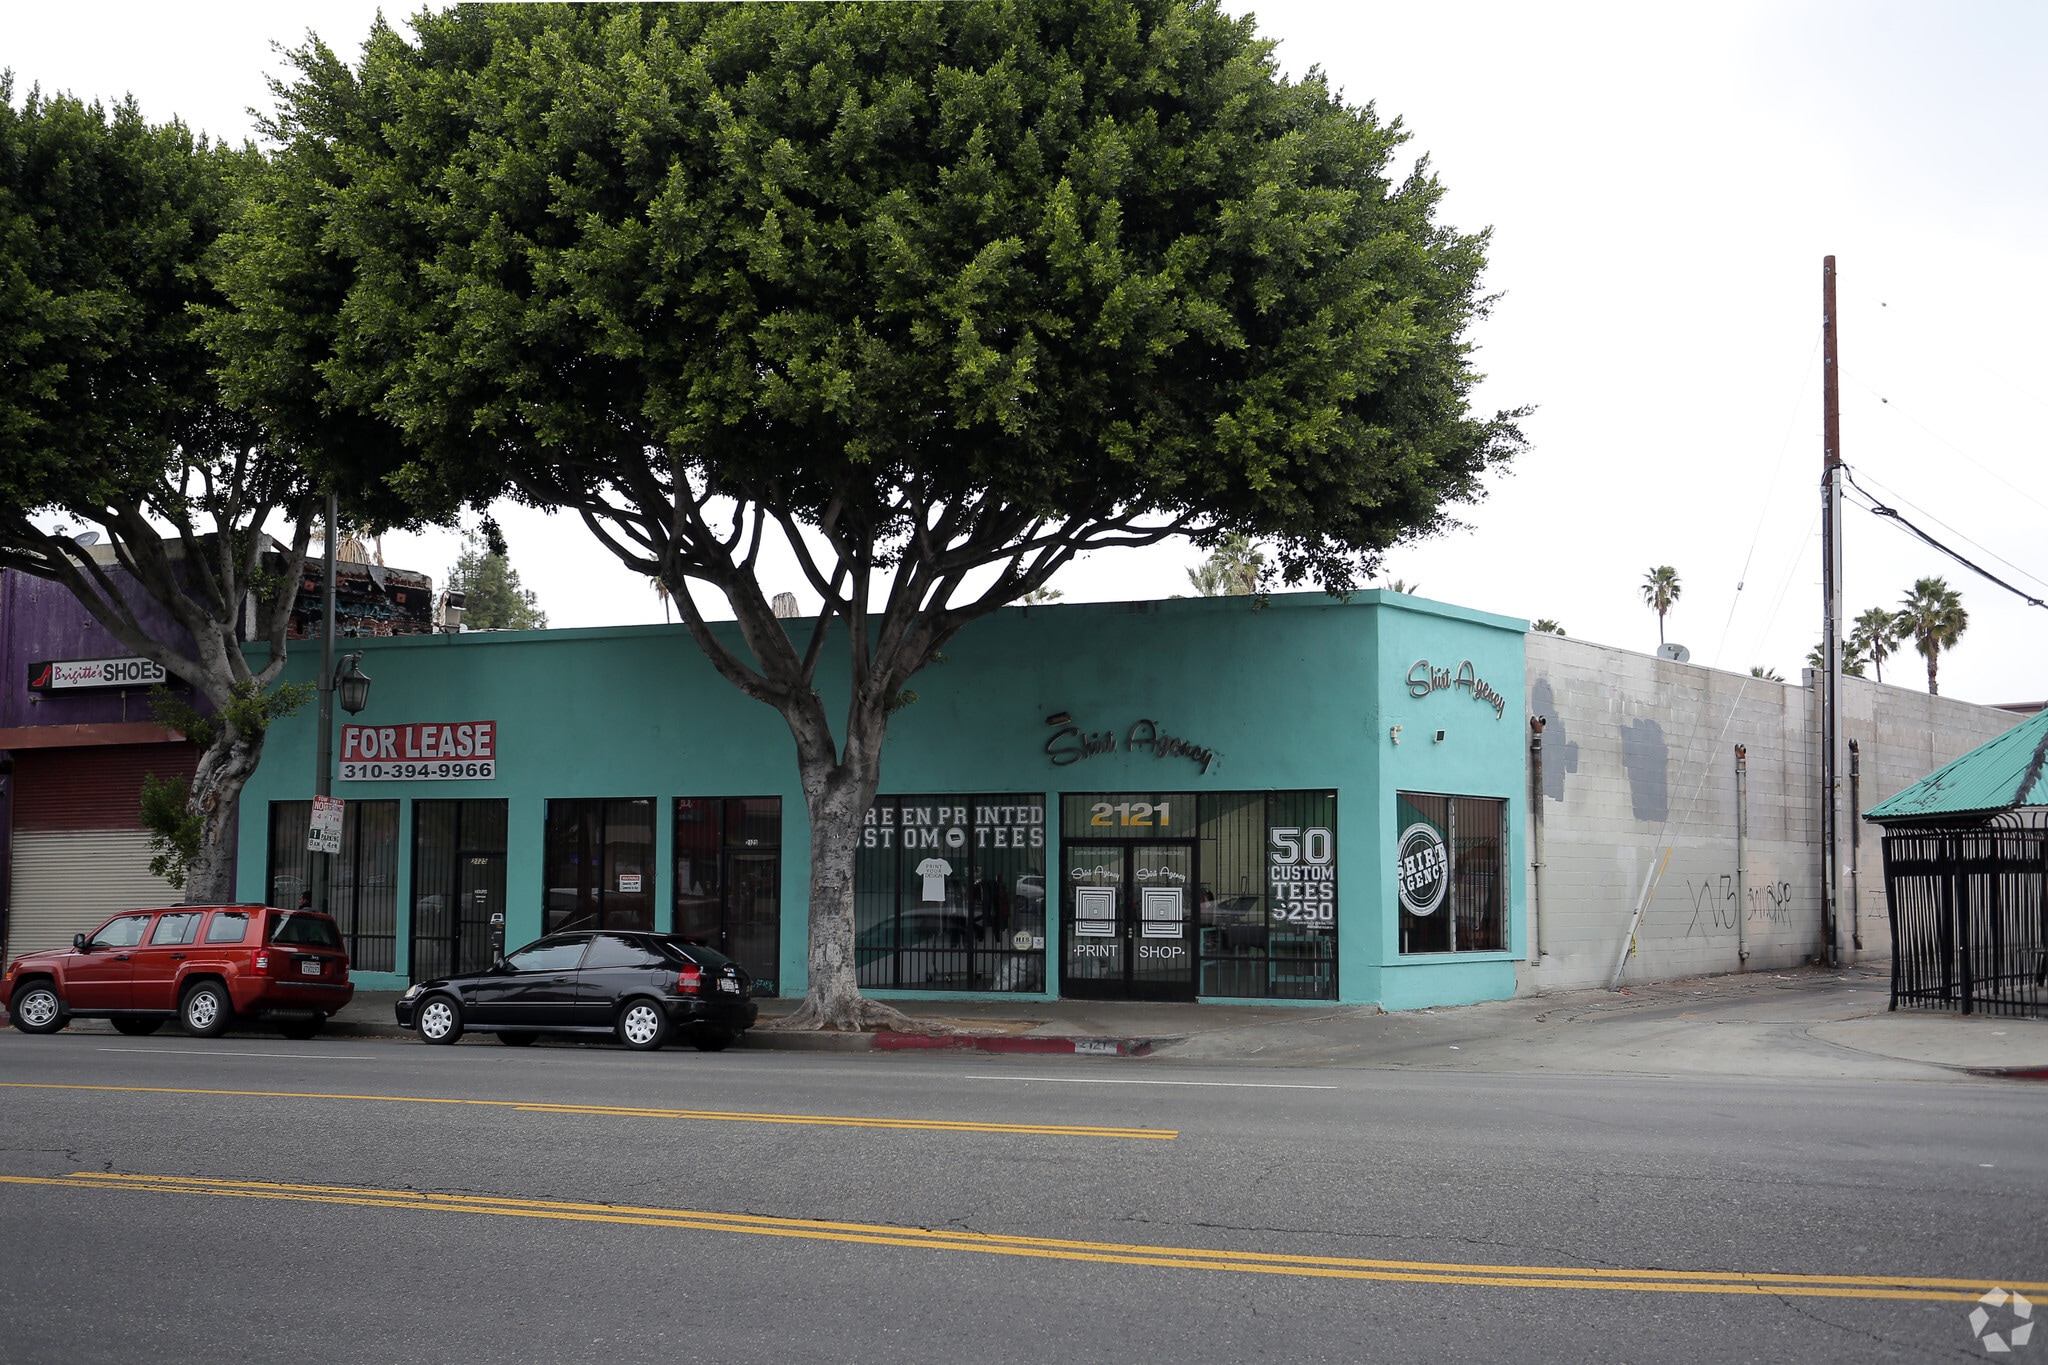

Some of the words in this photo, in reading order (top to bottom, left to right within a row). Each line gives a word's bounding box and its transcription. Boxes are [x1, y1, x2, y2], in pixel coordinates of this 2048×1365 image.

[54, 664, 103, 684] Brigitte's
[103, 661, 164, 681] SHOES
[1405, 659, 1452, 698] Shirt
[1453, 659, 1505, 720] Agency
[344, 727, 398, 759] FOR
[405, 724, 491, 758] LEASE
[1126, 719, 1214, 775] Agency
[344, 762, 492, 779] 310-394-9966
[313, 801, 324, 811] NO
[864, 806, 931, 826] REEN
[938, 805, 1044, 825] PRINTED
[1091, 802, 1170, 826] 2121
[856, 827, 940, 849] STOM
[975, 827, 1044, 848] TEES
[1270, 827, 1333, 865] 50
[1271, 865, 1334, 880] CUSTOM
[1398, 842, 1446, 880] SHIRT
[1399, 860, 1449, 896] AGENCY
[1272, 882, 1334, 900] TEES
